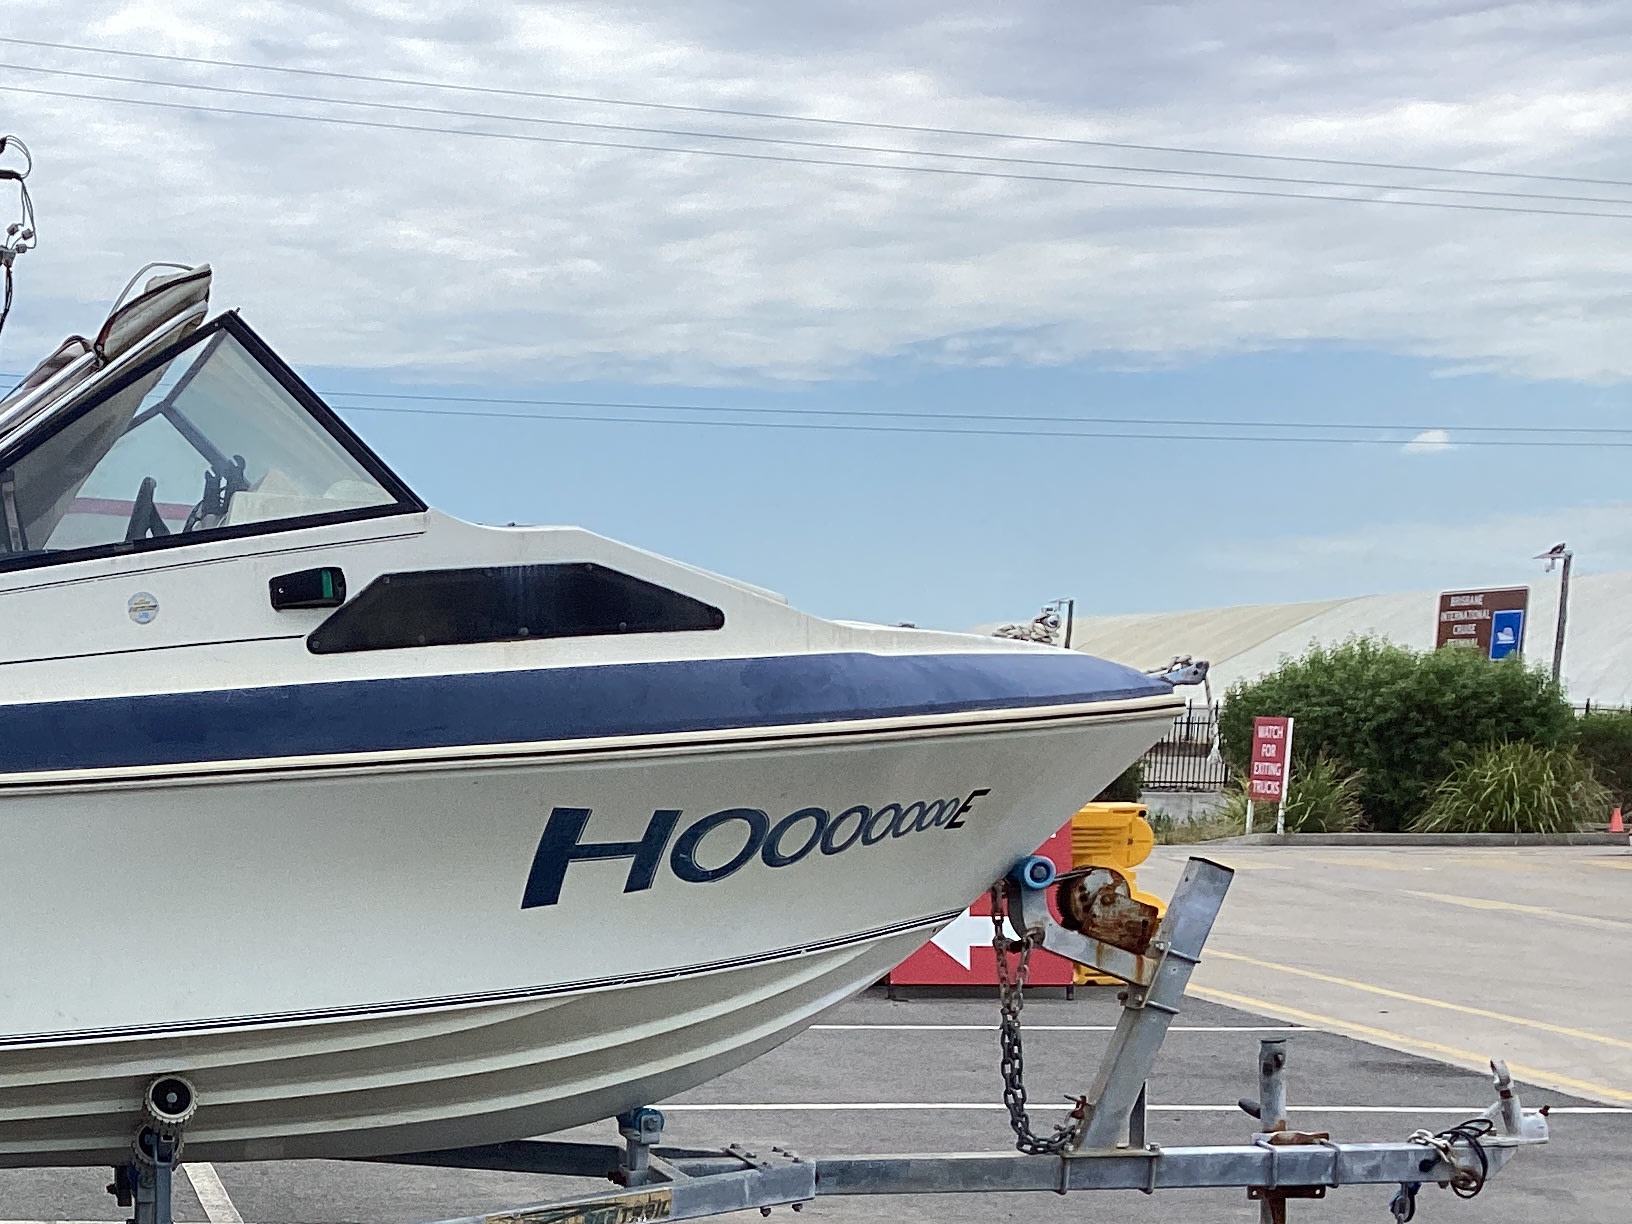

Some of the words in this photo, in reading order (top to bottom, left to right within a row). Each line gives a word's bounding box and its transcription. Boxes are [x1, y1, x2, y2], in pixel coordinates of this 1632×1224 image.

[1257, 725, 1284, 739] WATCH
[1261, 743, 1277, 758] FOR
[1253, 761, 1282, 776] EXITING
[1252, 779, 1280, 795] TRUCKS
